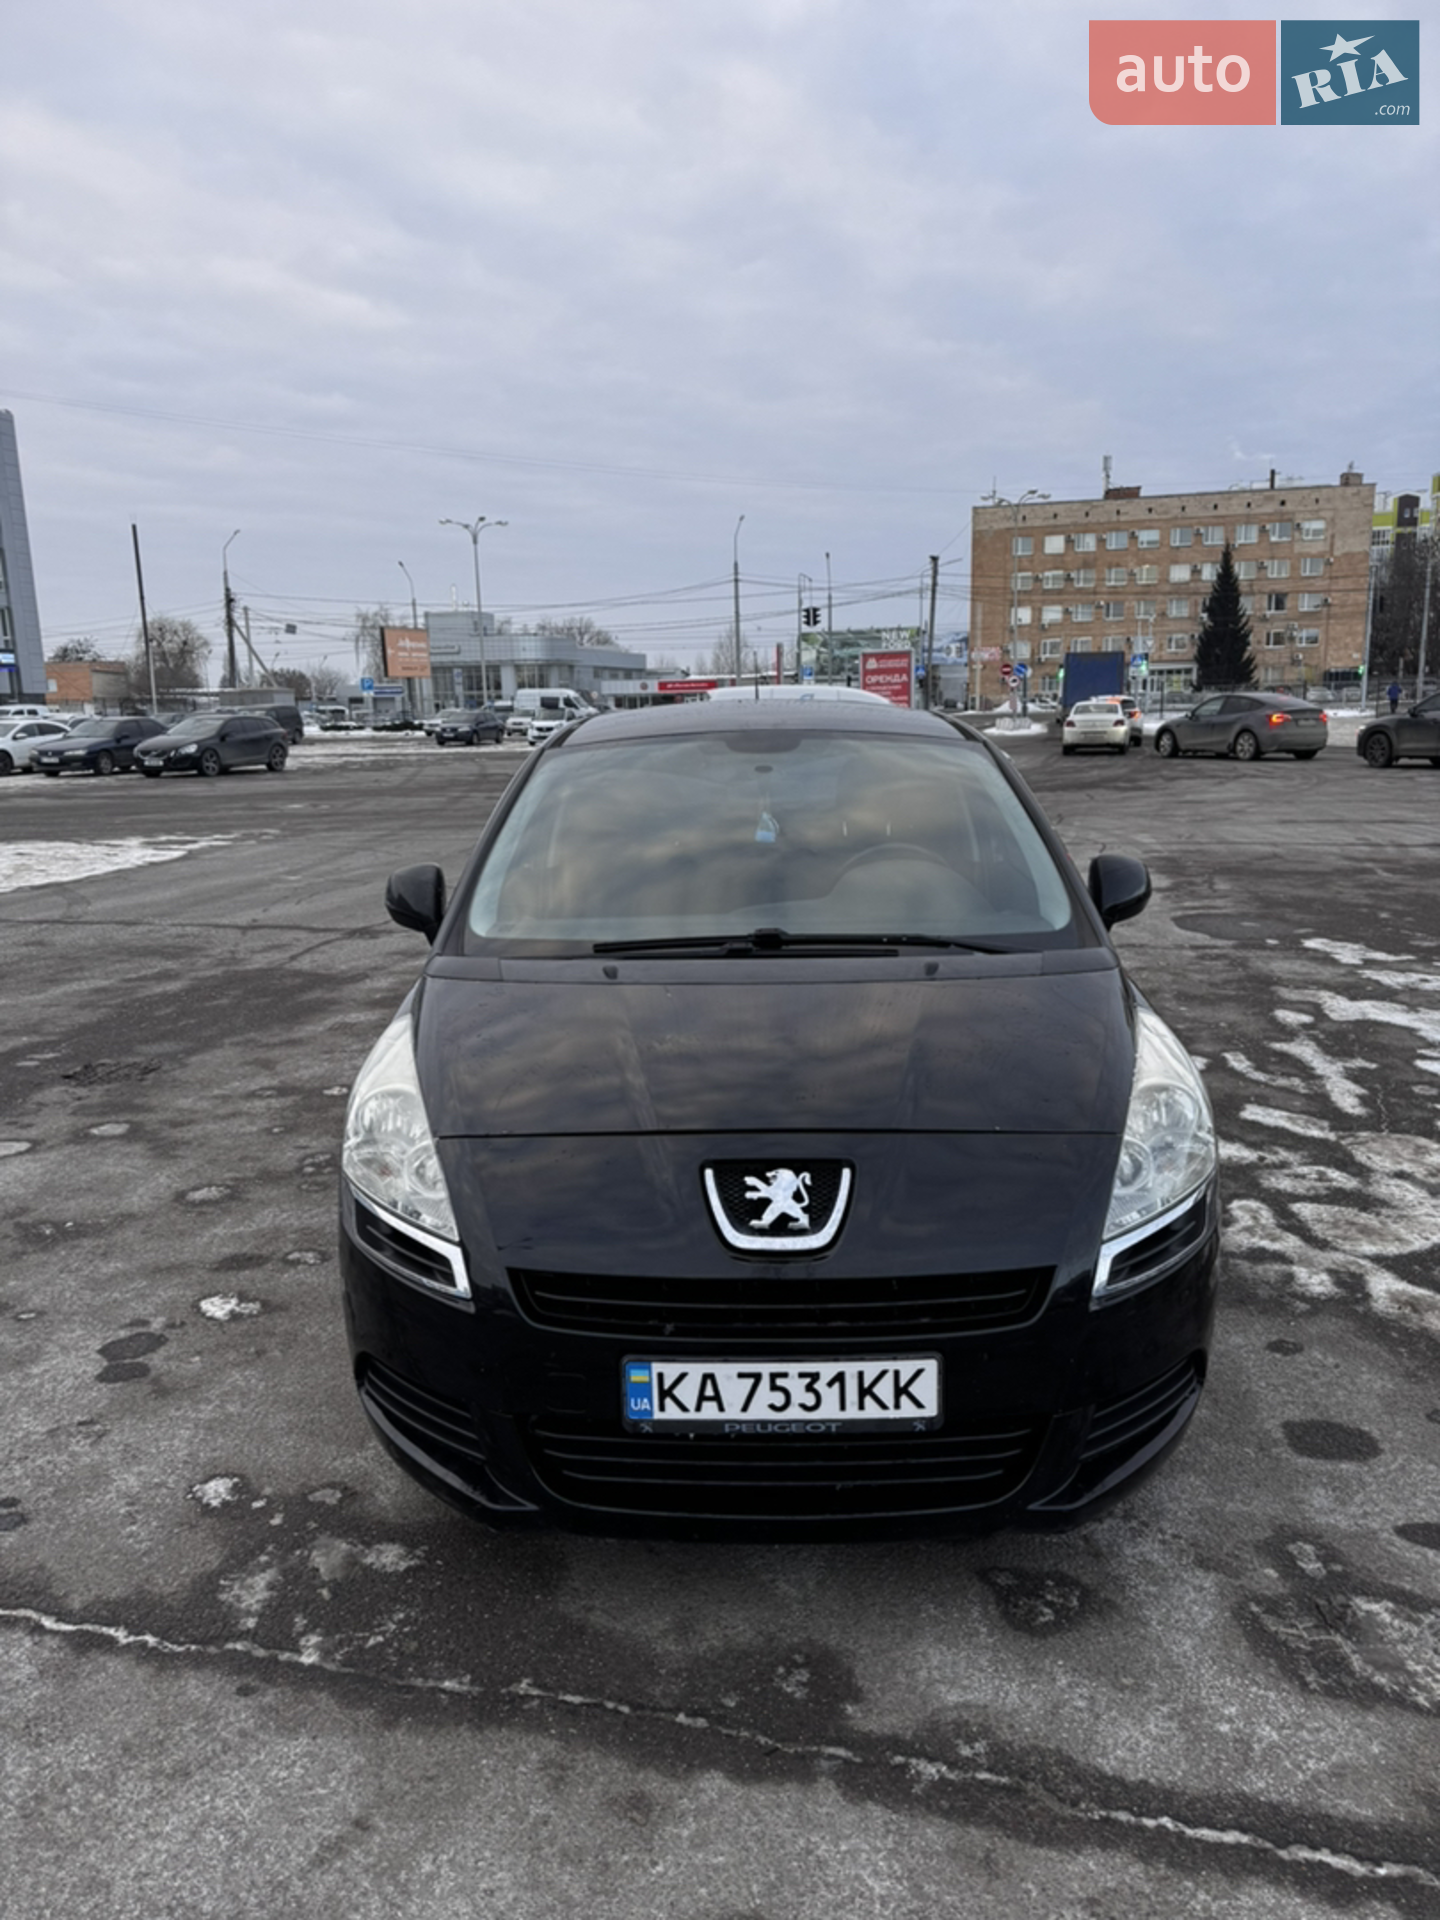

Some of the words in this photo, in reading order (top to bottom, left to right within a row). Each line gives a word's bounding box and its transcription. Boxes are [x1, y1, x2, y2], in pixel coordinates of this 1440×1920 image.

[865, 673, 908, 684] ОРЕНДА
[630, 1398, 651, 1411] UA
[723, 1422, 842, 1434] PEUGEOT
